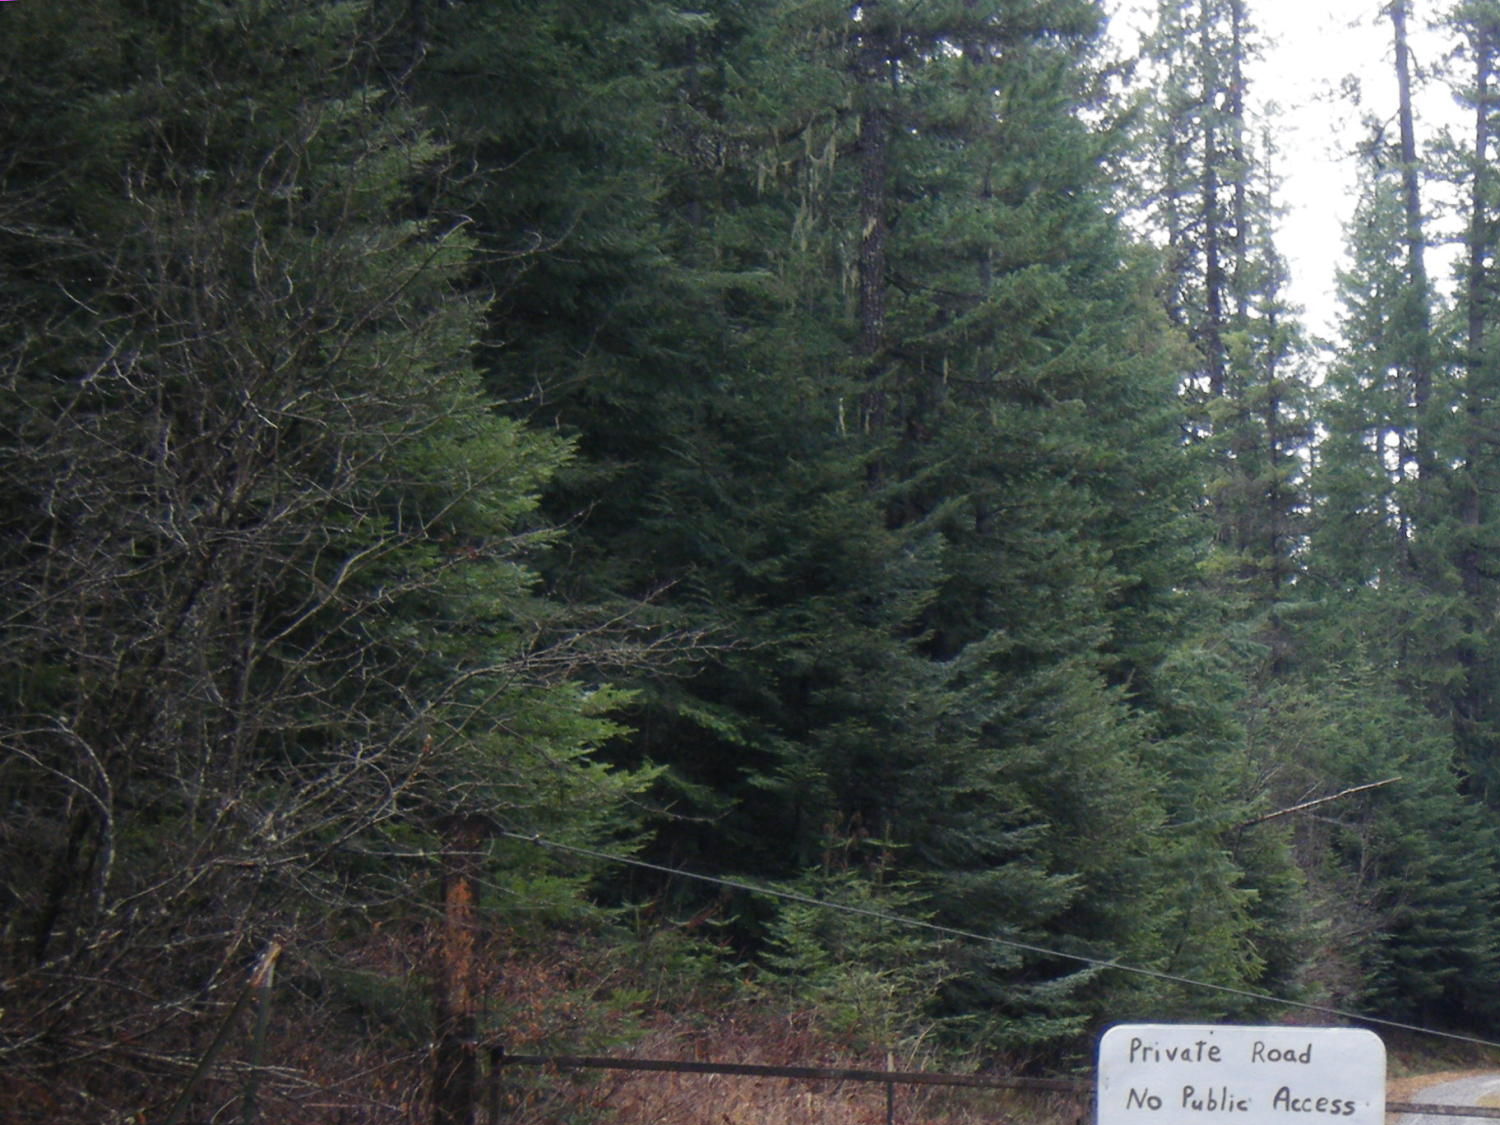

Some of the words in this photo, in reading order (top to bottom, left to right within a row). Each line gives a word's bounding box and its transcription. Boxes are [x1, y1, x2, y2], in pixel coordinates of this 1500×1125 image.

[1129, 1037, 1222, 1063] Private
[1251, 1040, 1312, 1065] Road
[1126, 1087, 1163, 1111] No
[1182, 1085, 1248, 1112] Public
[1272, 1086, 1356, 1116] Access
